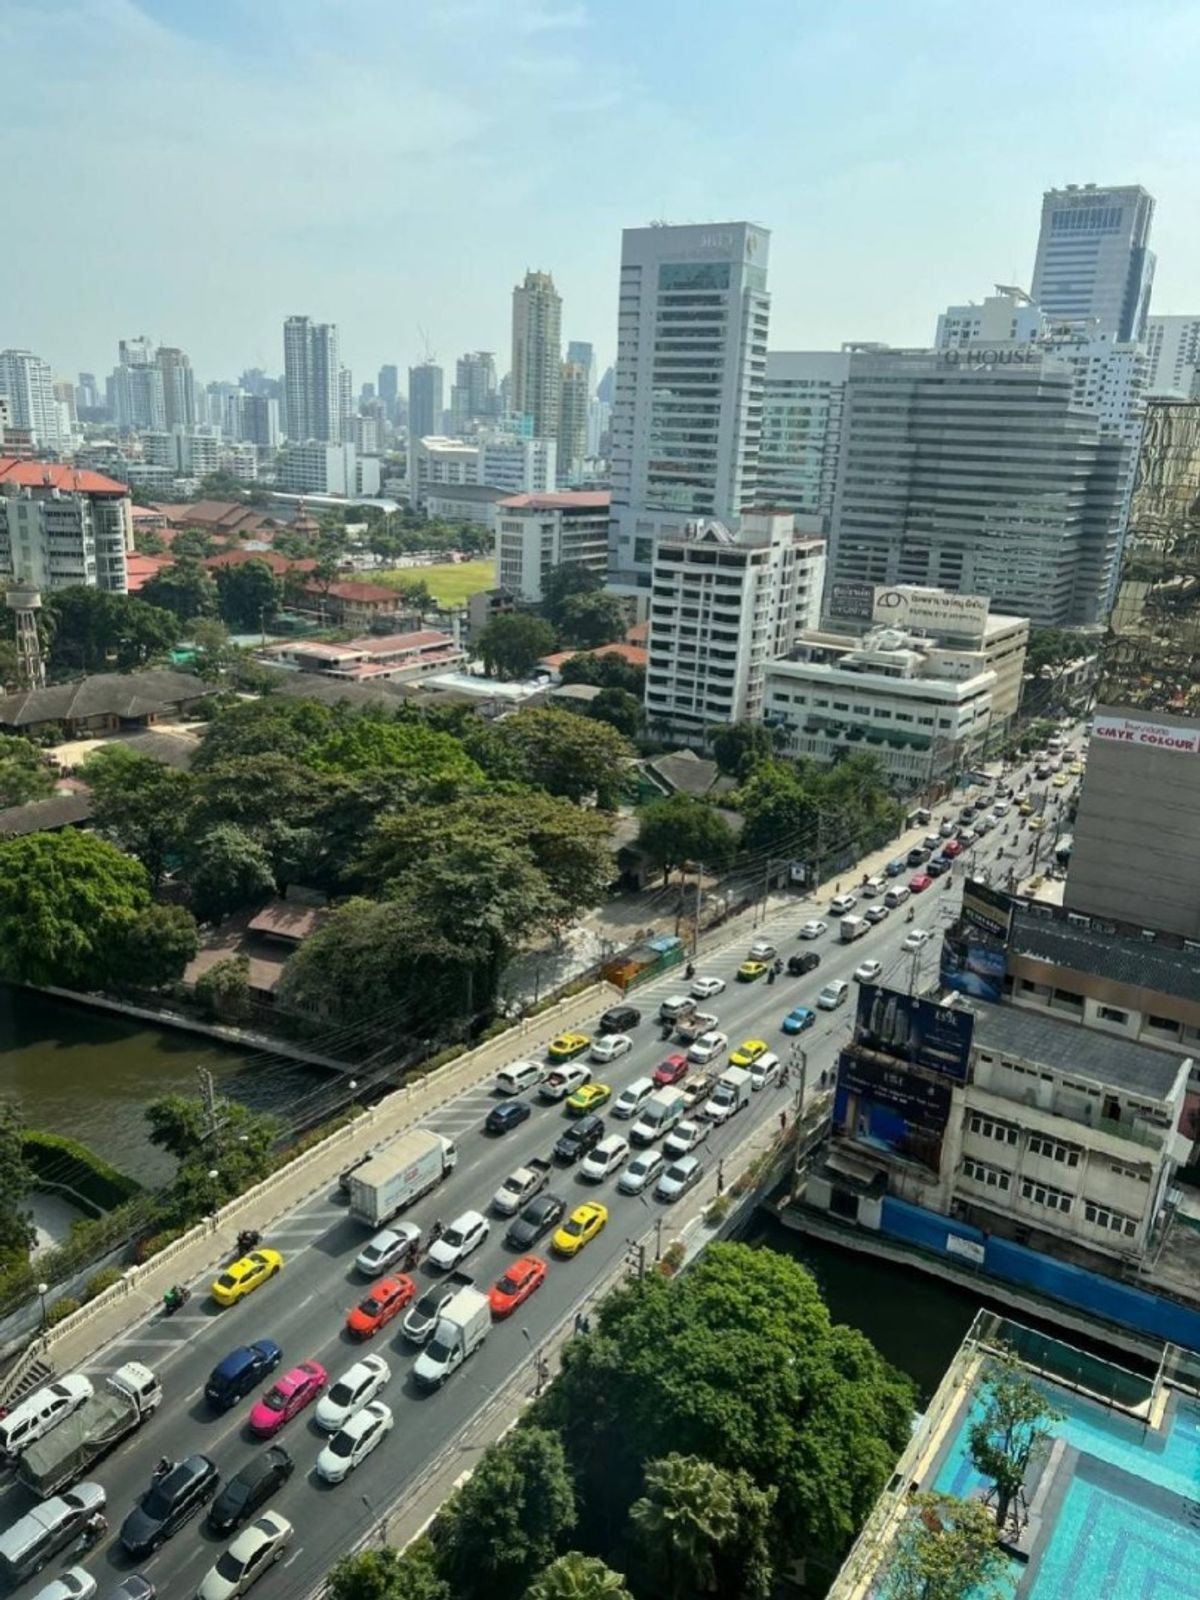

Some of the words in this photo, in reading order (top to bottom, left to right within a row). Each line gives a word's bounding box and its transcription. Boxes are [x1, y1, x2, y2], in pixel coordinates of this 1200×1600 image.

[966, 349, 1036, 365] HOUSE
[1096, 727, 1135, 740] CMYK
[1140, 733, 1195, 750] COLOUR
